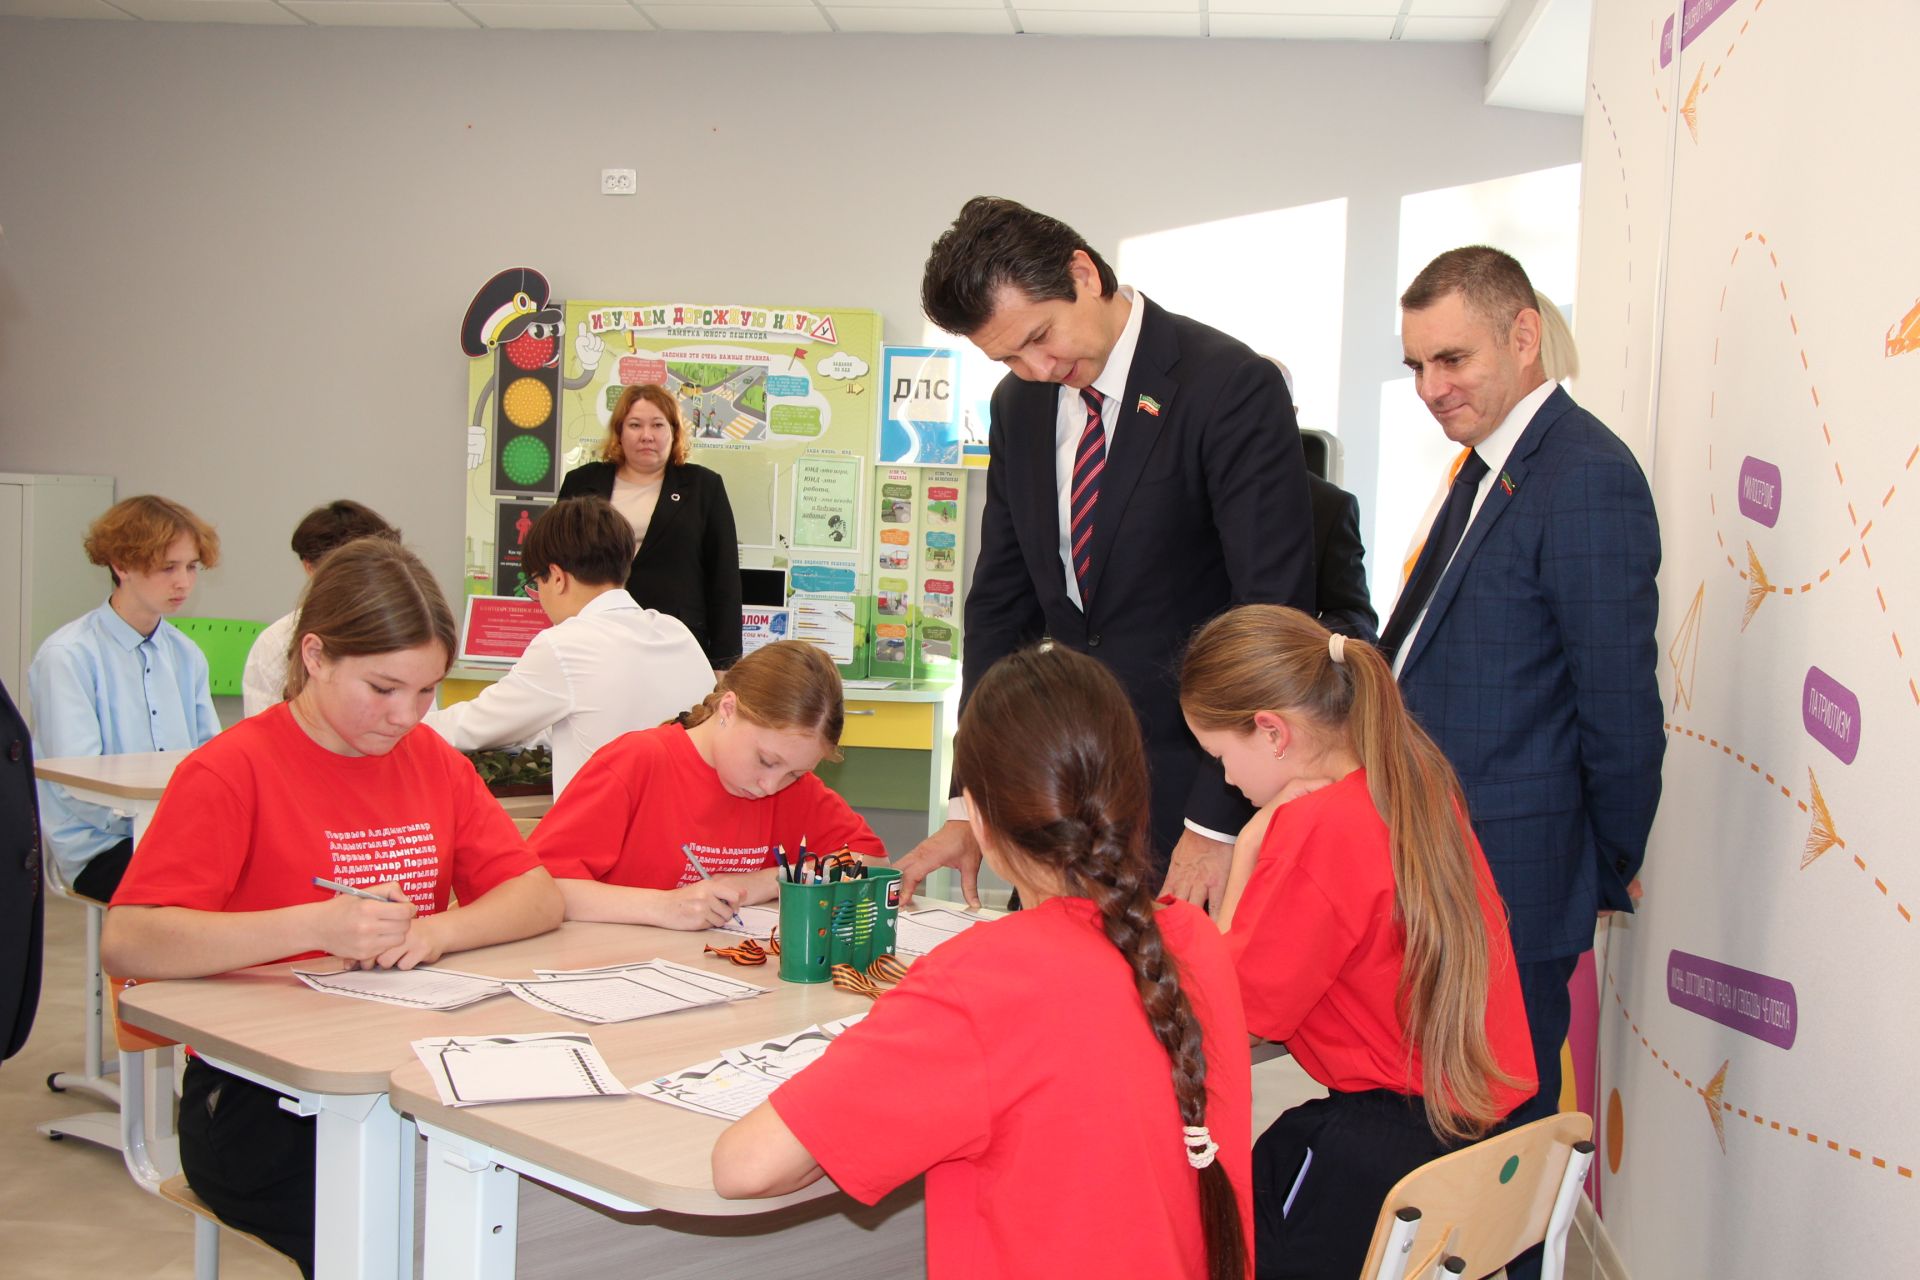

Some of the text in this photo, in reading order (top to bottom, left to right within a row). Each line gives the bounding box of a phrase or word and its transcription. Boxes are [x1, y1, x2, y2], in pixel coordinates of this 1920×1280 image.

[592, 309, 666, 330] ИЗУЧАЕМ
[673, 307, 766, 327] ДОРОЖНУЮ
[667, 329, 768, 340] ПАМЯТКА ЮНОГО ПЕШЕХОДА
[894, 378, 950, 402] ДПС
[1808, 688, 1852, 743] ПАТРИОТИЗМ
[325, 822, 431, 840] Первые Алдынгылар
[330, 834, 434, 851] Алдынгылар Первые
[690, 842, 720, 855] Первые
[332, 844, 437, 862] Первые Алдынгылар
[688, 856, 740, 865] лдынгылар
[334, 857, 438, 874] Алдынгылар Первые
[379, 868, 438, 883] Алдынгылар
